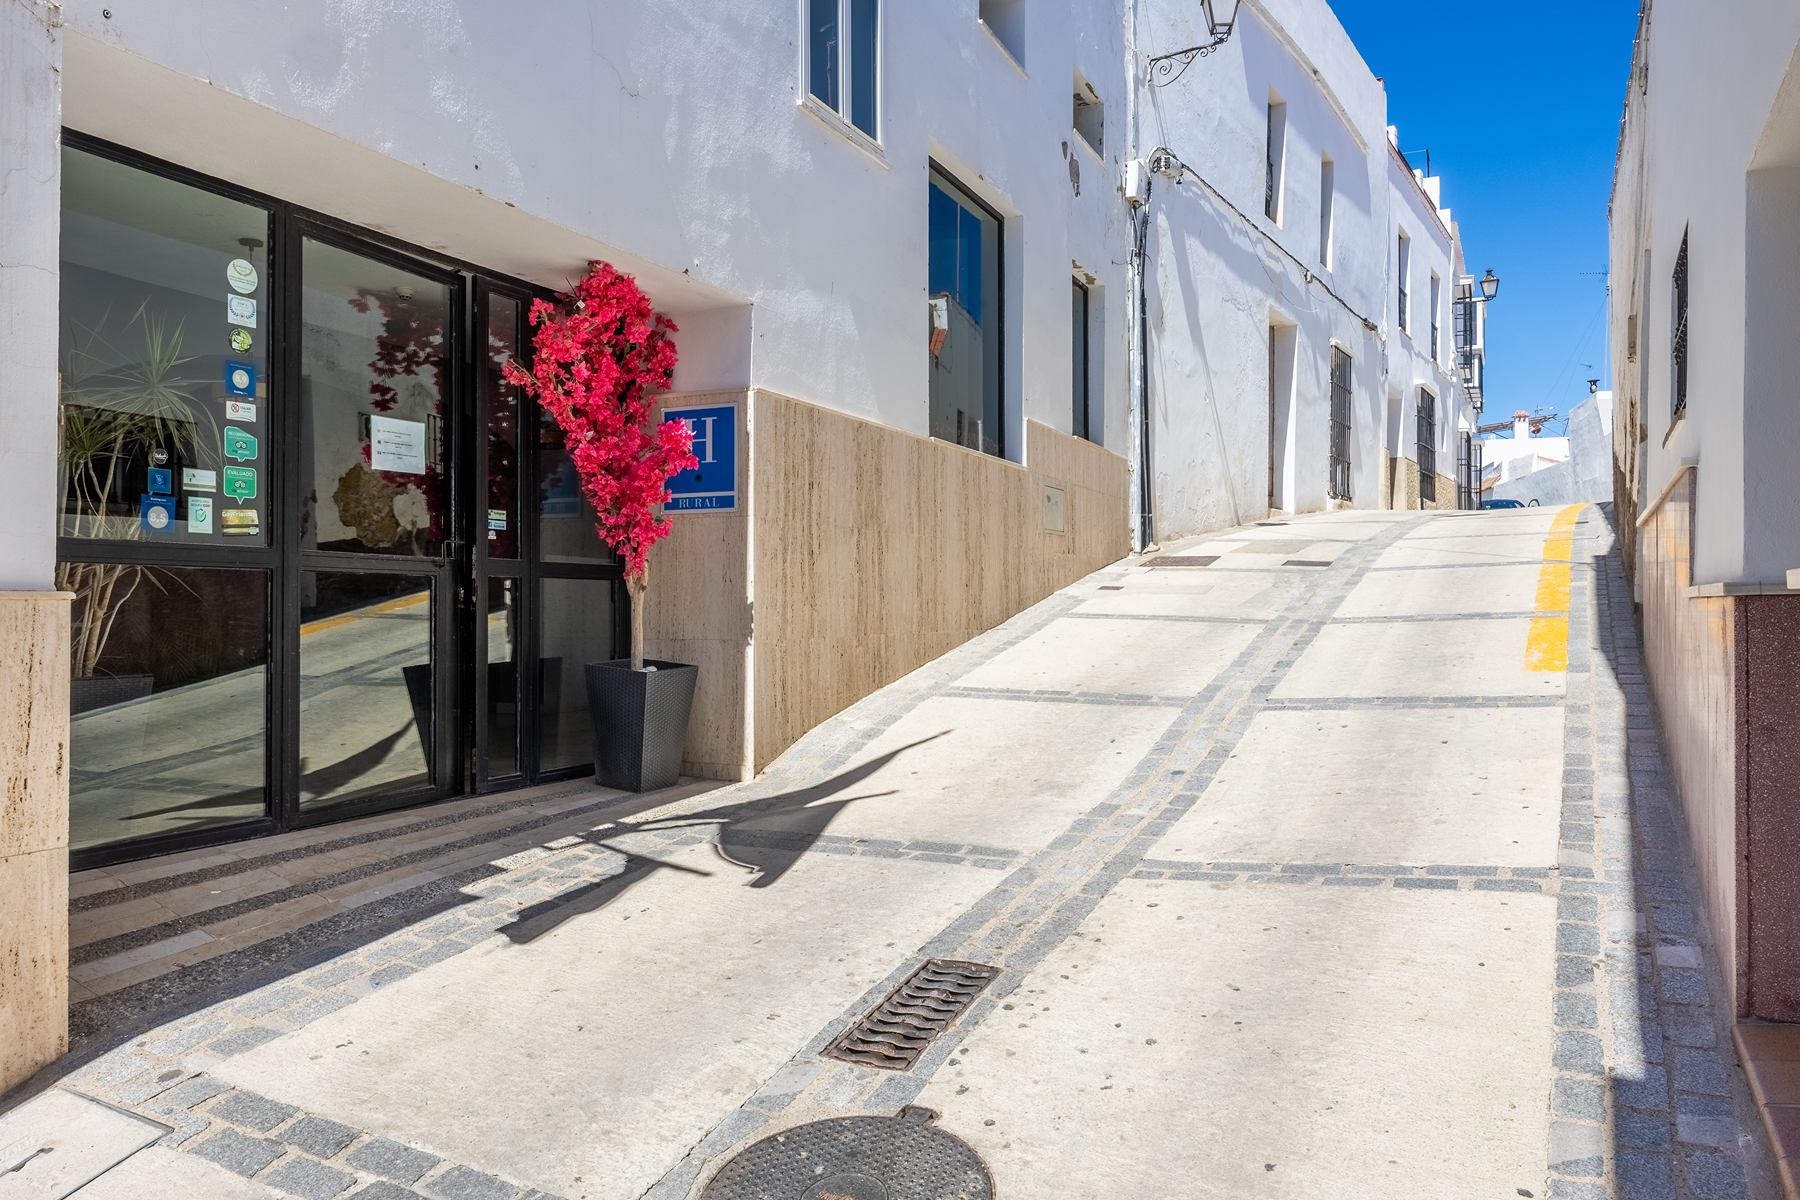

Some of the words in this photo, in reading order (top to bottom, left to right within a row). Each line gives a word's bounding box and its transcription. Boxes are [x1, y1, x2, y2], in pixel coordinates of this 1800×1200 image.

[235, 374, 247, 384] 8,9
[679, 497, 720, 509] RURAL
[150, 513, 166, 523] 8,5
